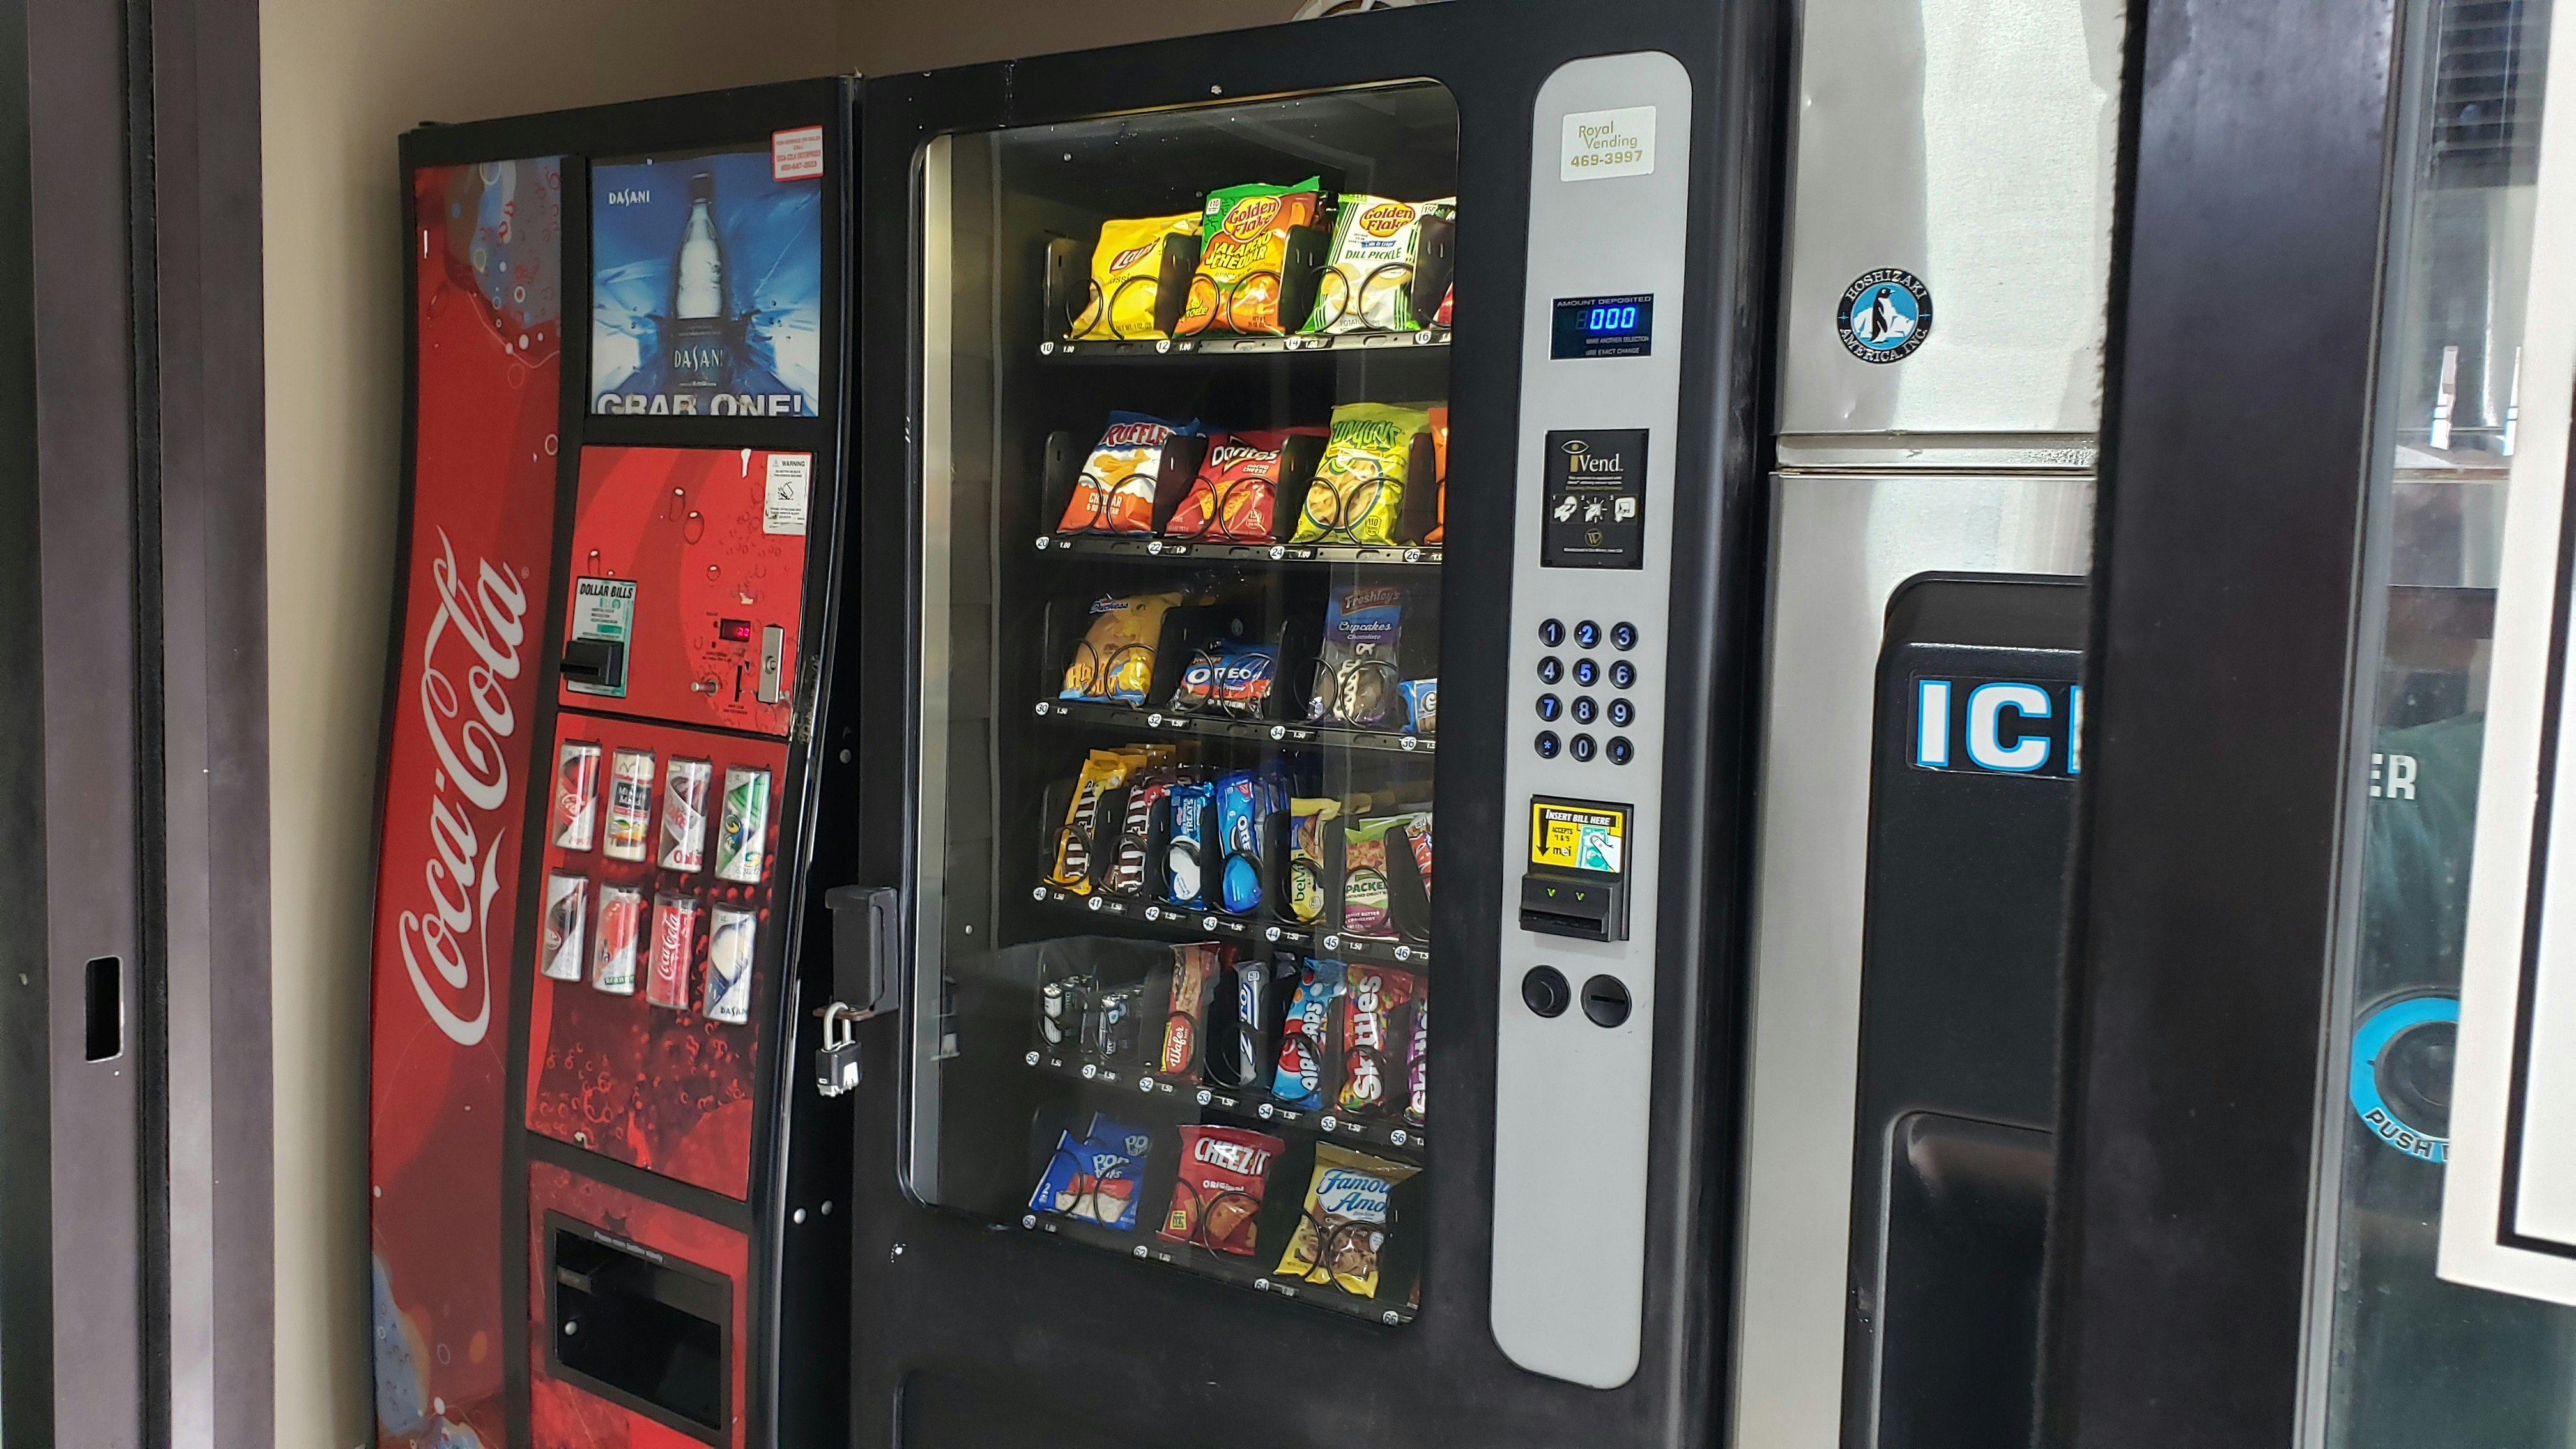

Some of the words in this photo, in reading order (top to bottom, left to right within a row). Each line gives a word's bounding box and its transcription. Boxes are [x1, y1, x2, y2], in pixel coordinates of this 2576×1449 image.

[1579, 121, 1613, 138] Royal
[1584, 135, 1637, 148] Vending
[1571, 150, 1643, 167] 469-3997
[609, 189, 650, 206] DASANI
[1228, 201, 1278, 224] Golden
[1363, 208, 1412, 220] Golden
[1230, 215, 1272, 236] Flake
[1345, 250, 1366, 259] DILL
[1368, 248, 1402, 259] PICKLE
[1845, 270, 1928, 302] HOSHIZAKI
[1598, 296, 1652, 305] DEPOSITED
[1590, 307, 1636, 330] 000
[1288, 339, 1299, 347] 14
[1418, 332, 1429, 341] 16
[1042, 344, 1052, 352] 10
[674, 345, 723, 372] DASANI
[1100, 422, 1174, 447] RUFFLE
[1212, 446, 1280, 466] Doritos
[1089, 493, 1123, 507] CHDAR
[1038, 539, 1048, 548] 20
[1150, 544, 1160, 553] 22
[1272, 548, 1284, 557] 24
[1407, 551, 1418, 560] 26
[580, 583, 610, 597] DOLLAR
[611, 586, 633, 599] BILLS
[1346, 591, 1400, 608] Freshley's
[1089, 600, 1128, 614] Duchess
[1338, 620, 1392, 634] Cupcakes
[1547, 624, 1555, 641] 1
[1582, 625, 1593, 643] 2
[1618, 627, 1630, 645] 3
[1188, 668, 1251, 684] OREO
[1544, 661, 1554, 678] 4
[1580, 664, 1591, 682] 5
[1616, 666, 1628, 683] 6
[1544, 699, 1554, 717] 7
[1579, 702, 1590, 719] 8
[1614, 704, 1627, 721] 9
[1149, 716, 1160, 724] 32
[1272, 728, 1284, 737] 34
[1578, 739, 1588, 756] 0
[399, 525, 530, 1046] Coca-Cola
[1545, 809, 1572, 821] INSERT
[1573, 814, 1588, 824] BILL
[1590, 816, 1611, 825] HERE
[1238, 815, 1250, 850] ORE
[1552, 826, 1573, 834] ACCEPTS
[1553, 846, 1571, 856] mei
[1346, 882, 1387, 893] PACKE
[1091, 899, 1100, 907] 41
[1204, 919, 1215, 928] 43
[1268, 930, 1278, 939] 44
[1325, 937, 1337, 947] 45
[1396, 948, 1409, 958] 46
[721, 1006, 748, 1016] DASAN
[1170, 1025, 1186, 1067] Wafer
[1298, 1002, 1323, 1091] AIRHADS
[1027, 1054, 1038, 1062] 50
[1140, 1080, 1152, 1088] 52
[1199, 1092, 1209, 1101] 53
[1260, 1107, 1271, 1116] 54
[1322, 1119, 1335, 1129] 55
[1392, 1132, 1405, 1142] 56
[2364, 1107, 2434, 1158] PUSH
[1044, 1183, 1051, 1192] 2
[1316, 1169, 1393, 1194] Famou
[1328, 1192, 1386, 1213] Amo
[1024, 1217, 1034, 1225] 60
[1384, 1313, 1397, 1321] 66
